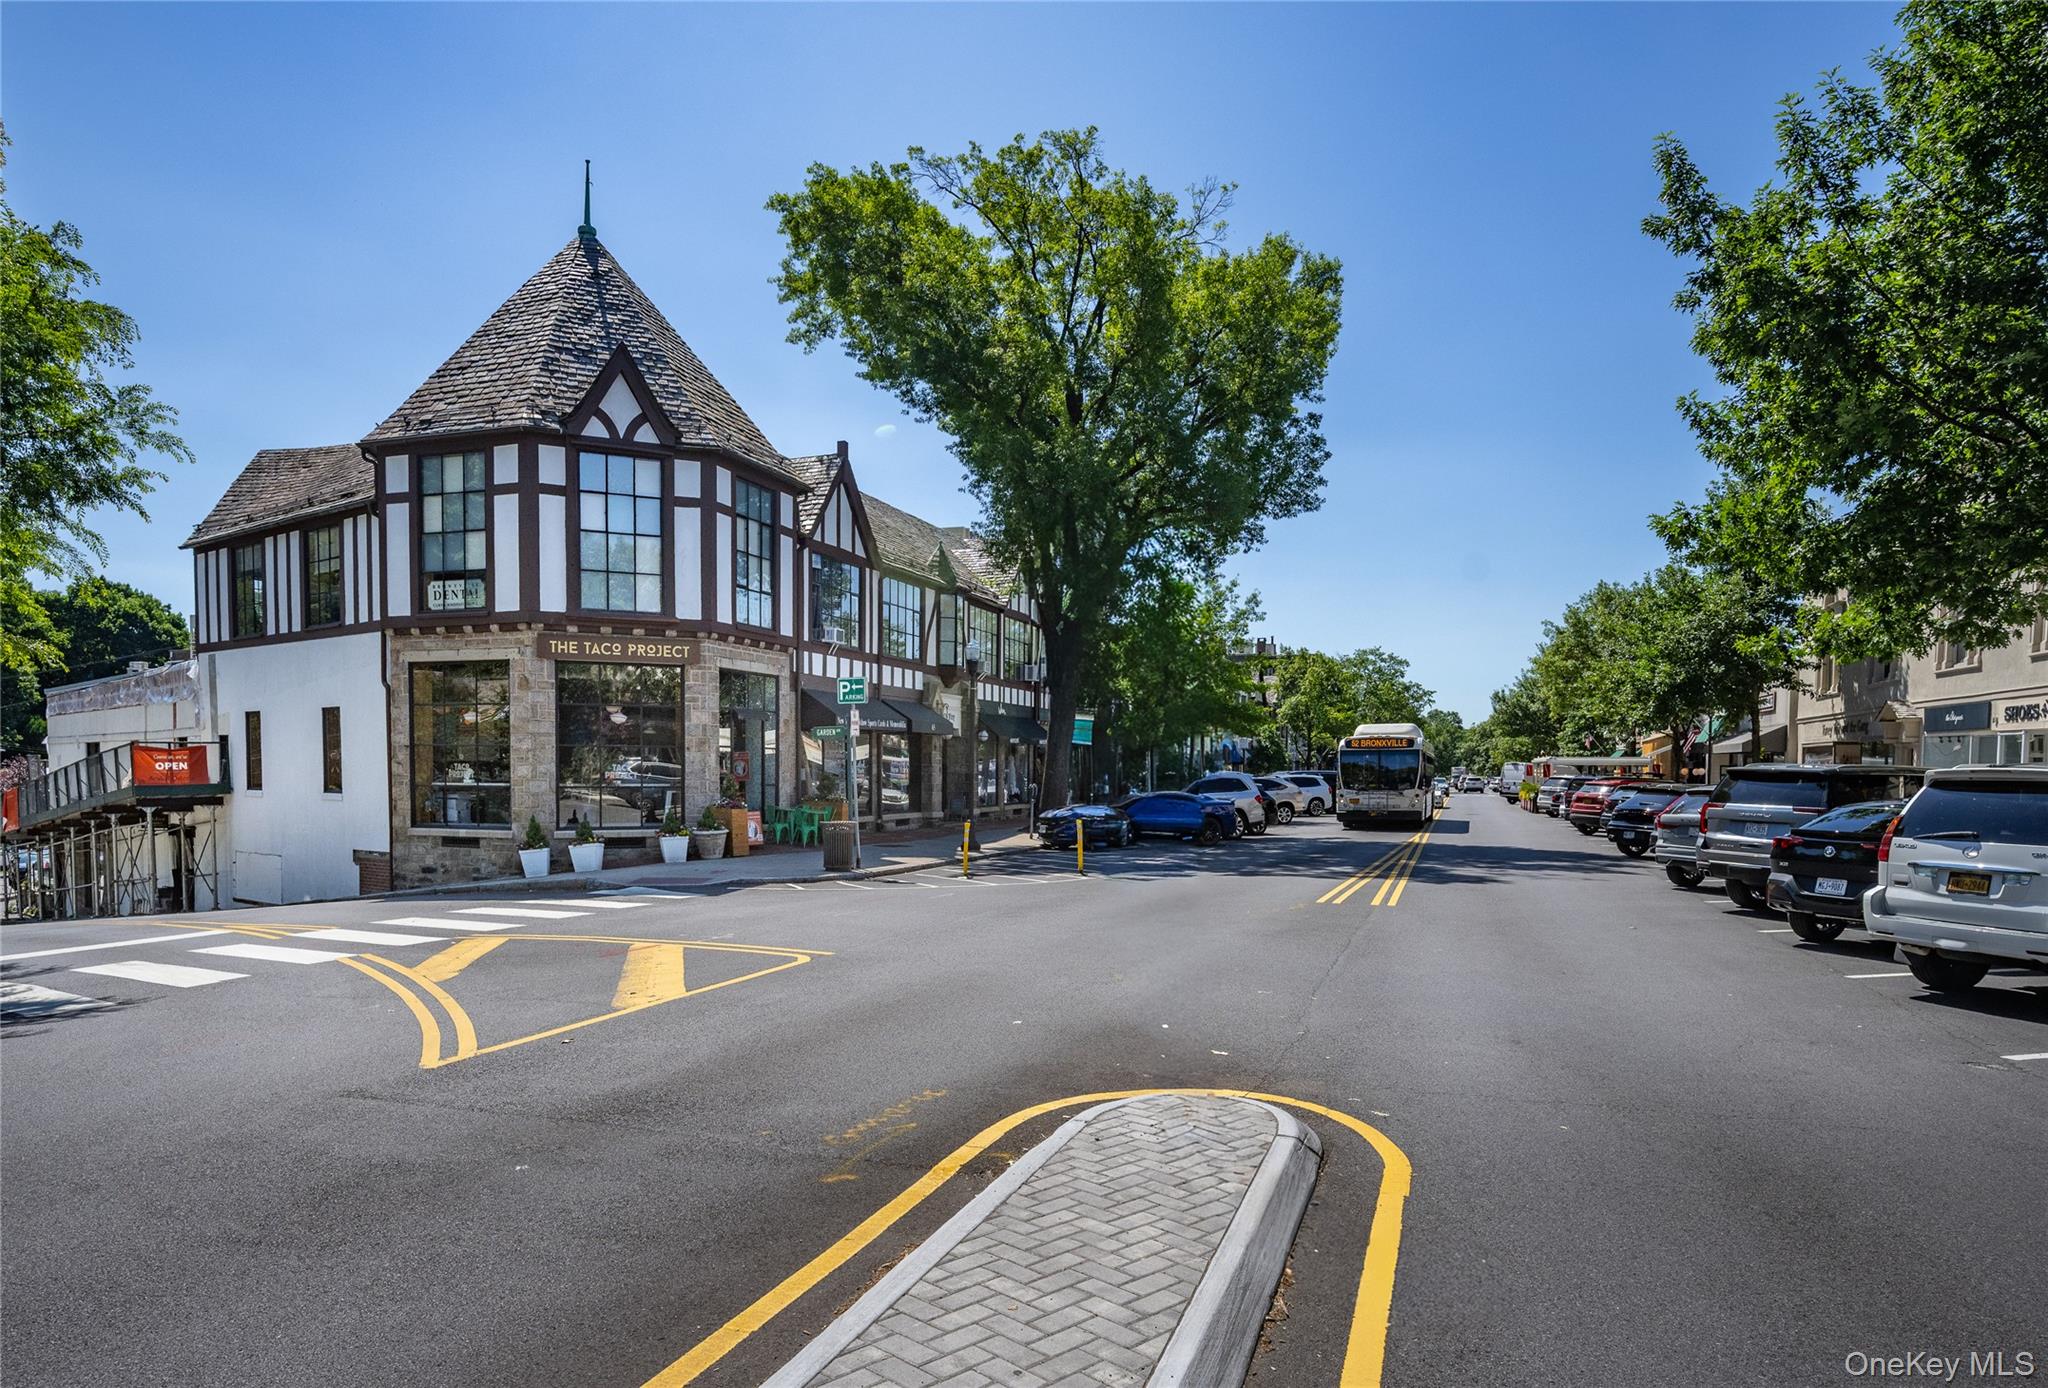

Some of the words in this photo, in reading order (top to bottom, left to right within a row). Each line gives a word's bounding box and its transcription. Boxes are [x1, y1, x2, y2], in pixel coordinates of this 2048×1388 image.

[549, 640, 579, 654] THE
[583, 641, 622, 656] TACO
[627, 643, 690, 658] PROJECT
[2004, 704, 2040, 723] SHOES
[816, 728, 836, 736] GARDEN
[1360, 739, 1408, 747] BRONXVILLE
[155, 761, 188, 771] OPEN
